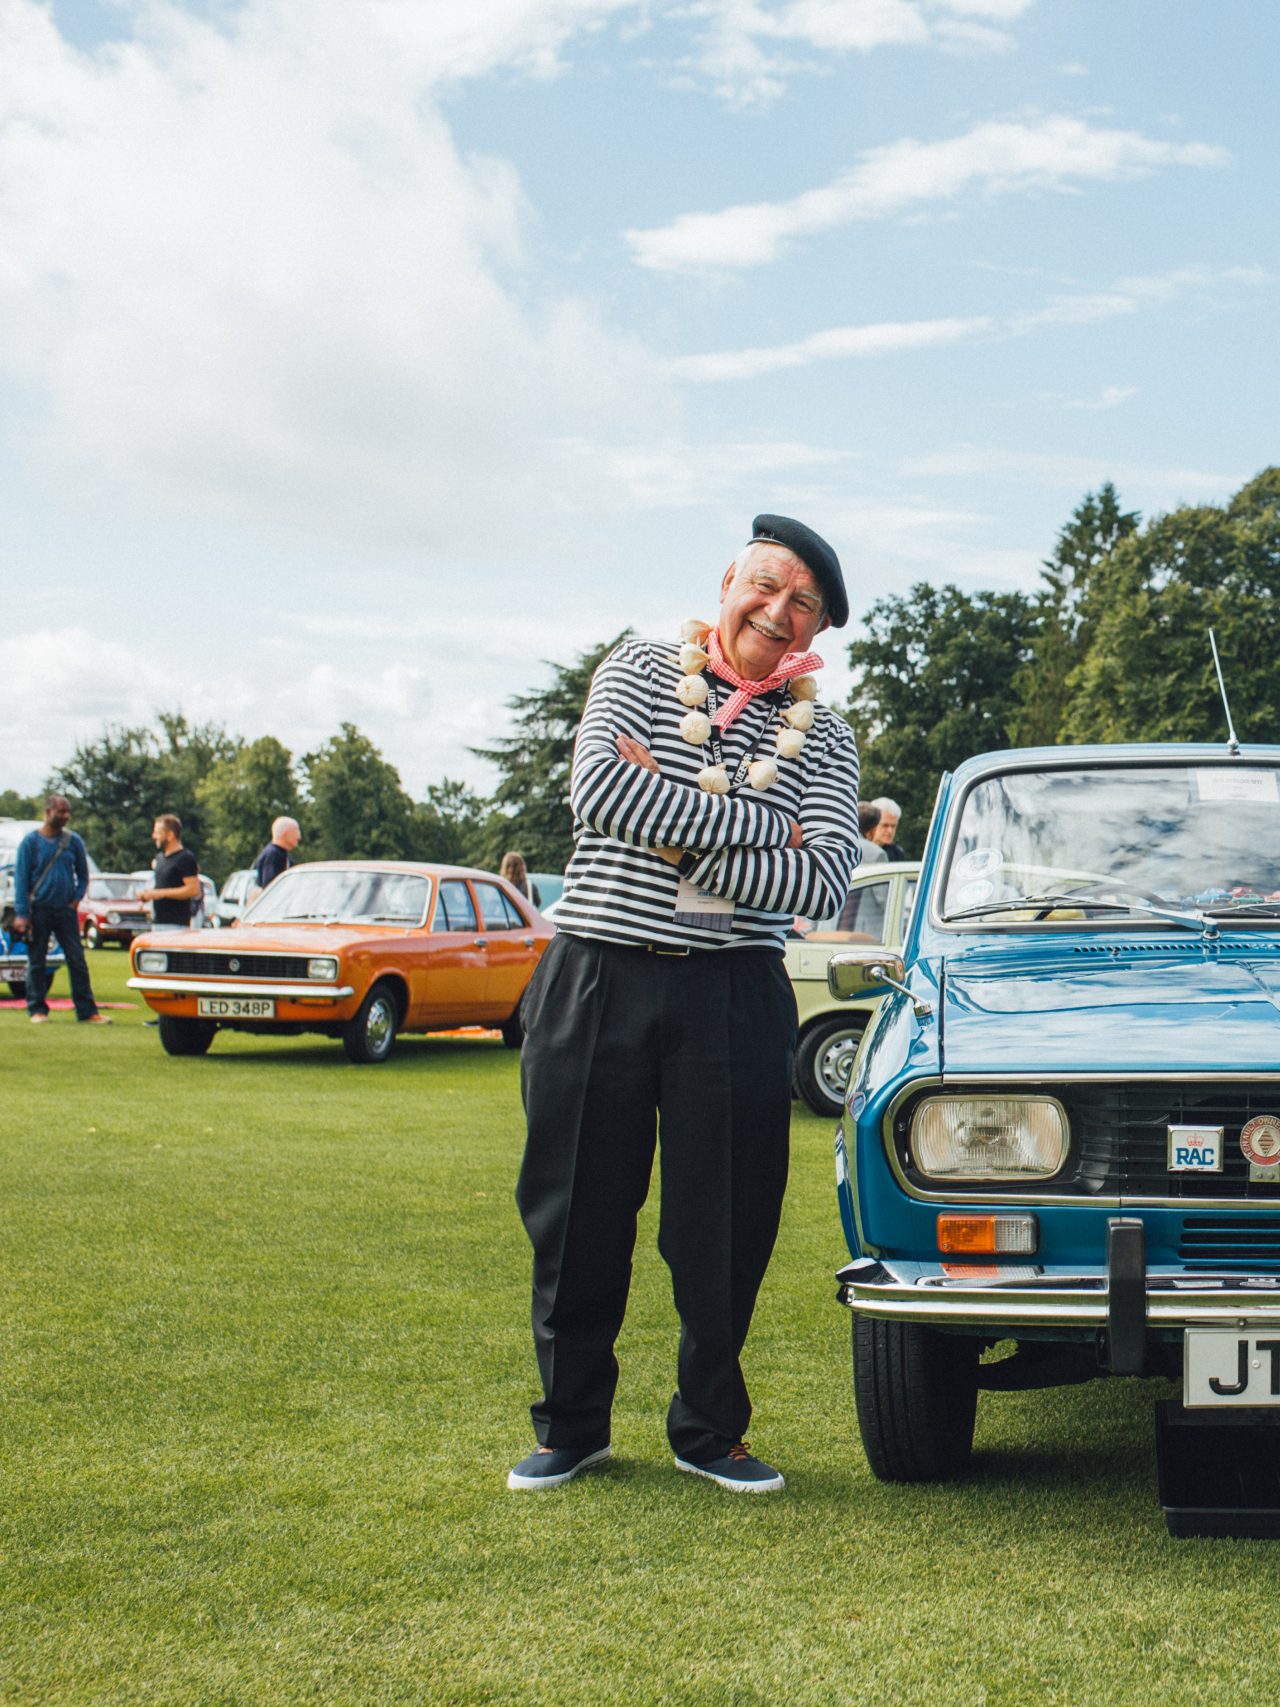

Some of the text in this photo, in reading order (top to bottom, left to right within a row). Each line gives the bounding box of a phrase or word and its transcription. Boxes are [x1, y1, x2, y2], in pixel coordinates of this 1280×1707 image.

[200, 1000, 271, 1016] LED 348P
[1242, 1121, 1257, 1158] RENAULT
[1175, 1147, 1215, 1165] RAC
